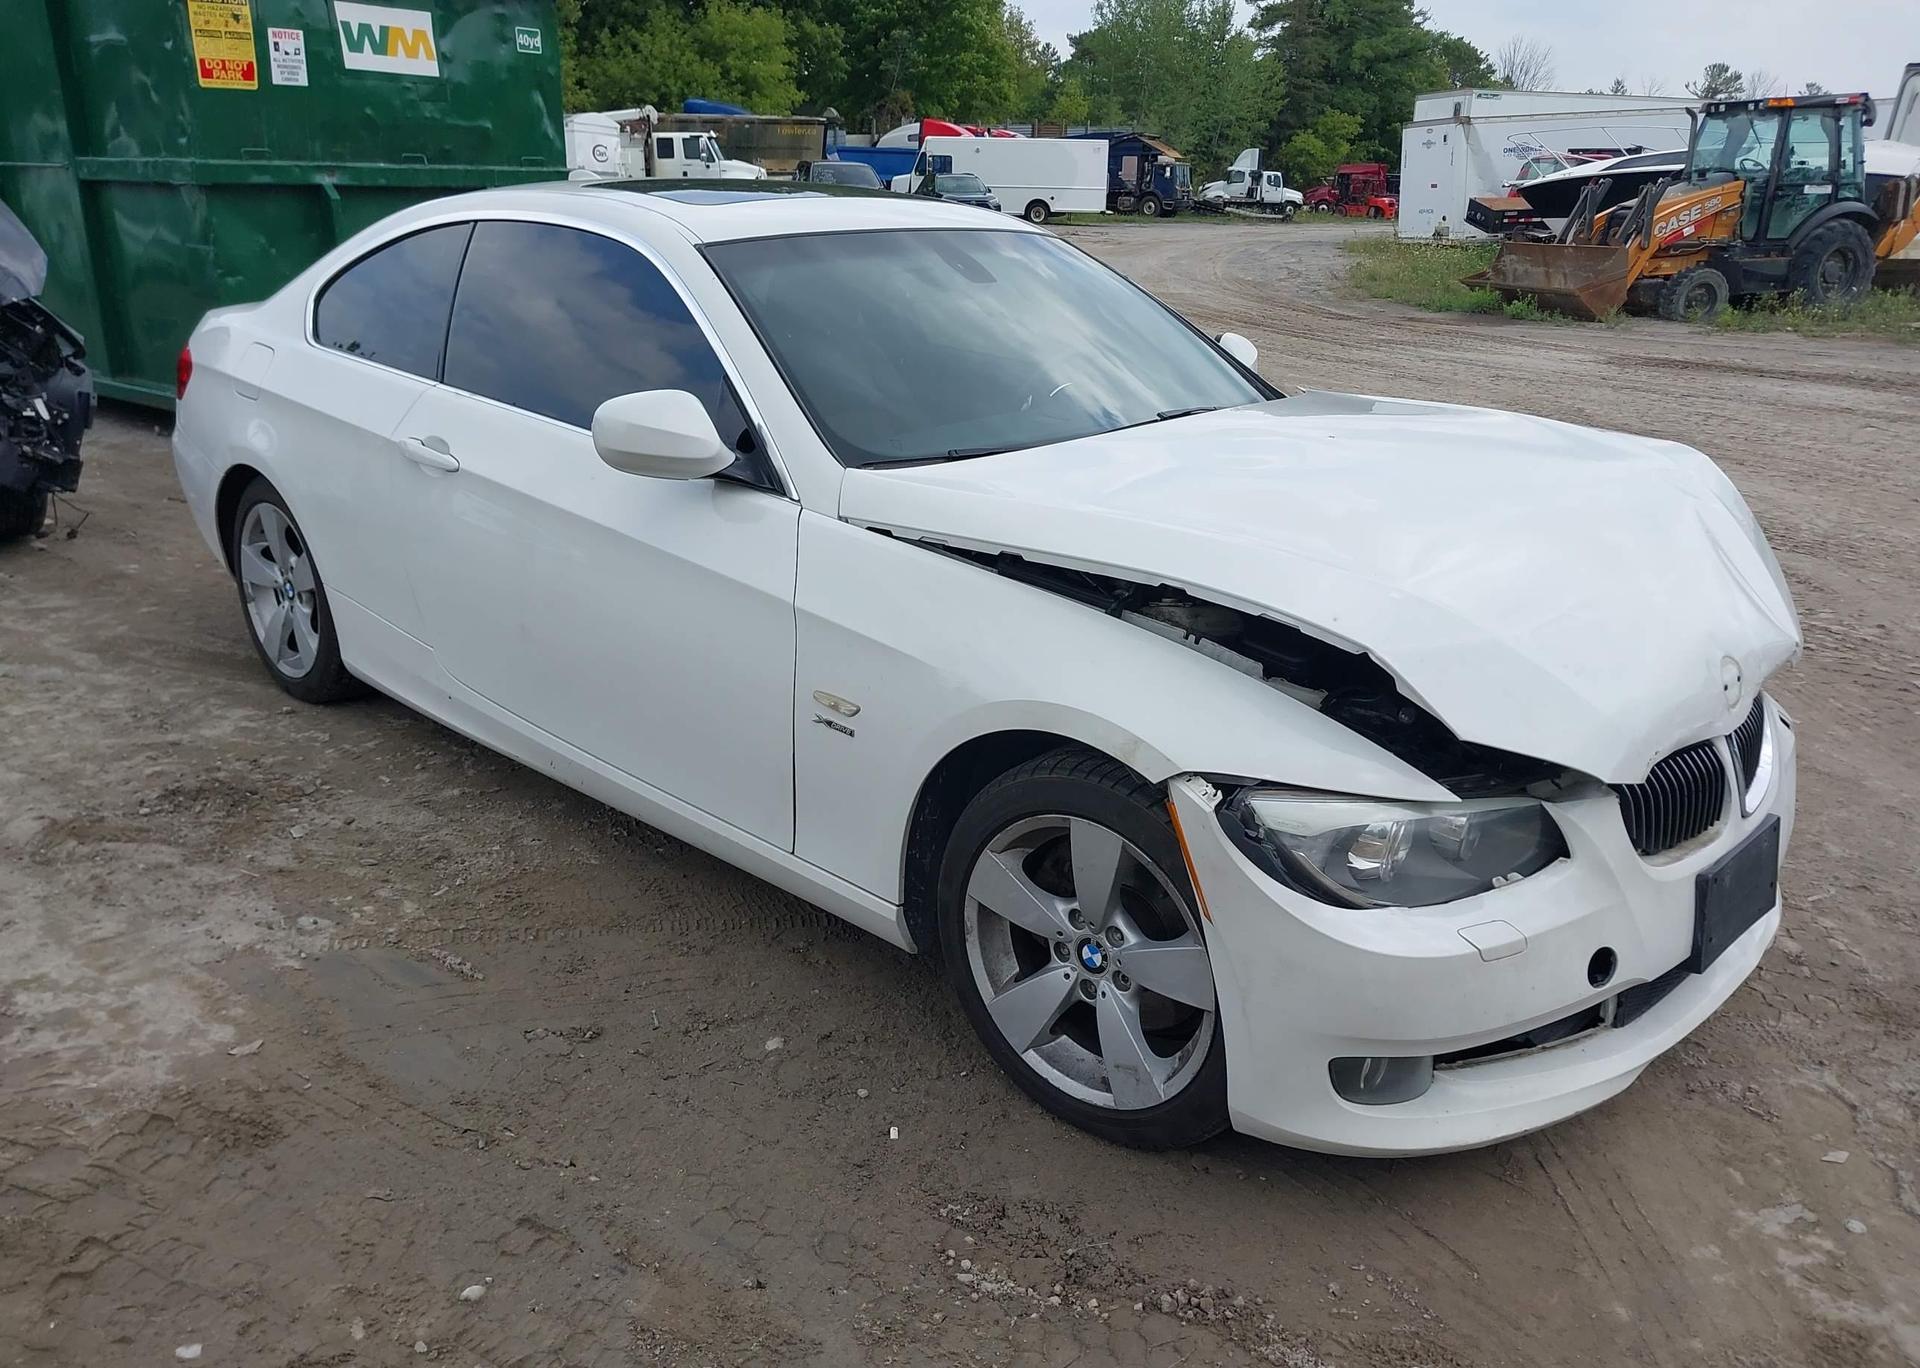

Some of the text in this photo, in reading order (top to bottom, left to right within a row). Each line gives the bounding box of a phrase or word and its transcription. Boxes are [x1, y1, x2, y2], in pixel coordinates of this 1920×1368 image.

[272, 30, 301, 40] NOTICE
[340, 20, 436, 61] WM
[518, 34, 541, 49] 40yd
[205, 59, 248, 71] DO NOT
[213, 69, 244, 81] PARK
[1655, 204, 1702, 237] CASE
